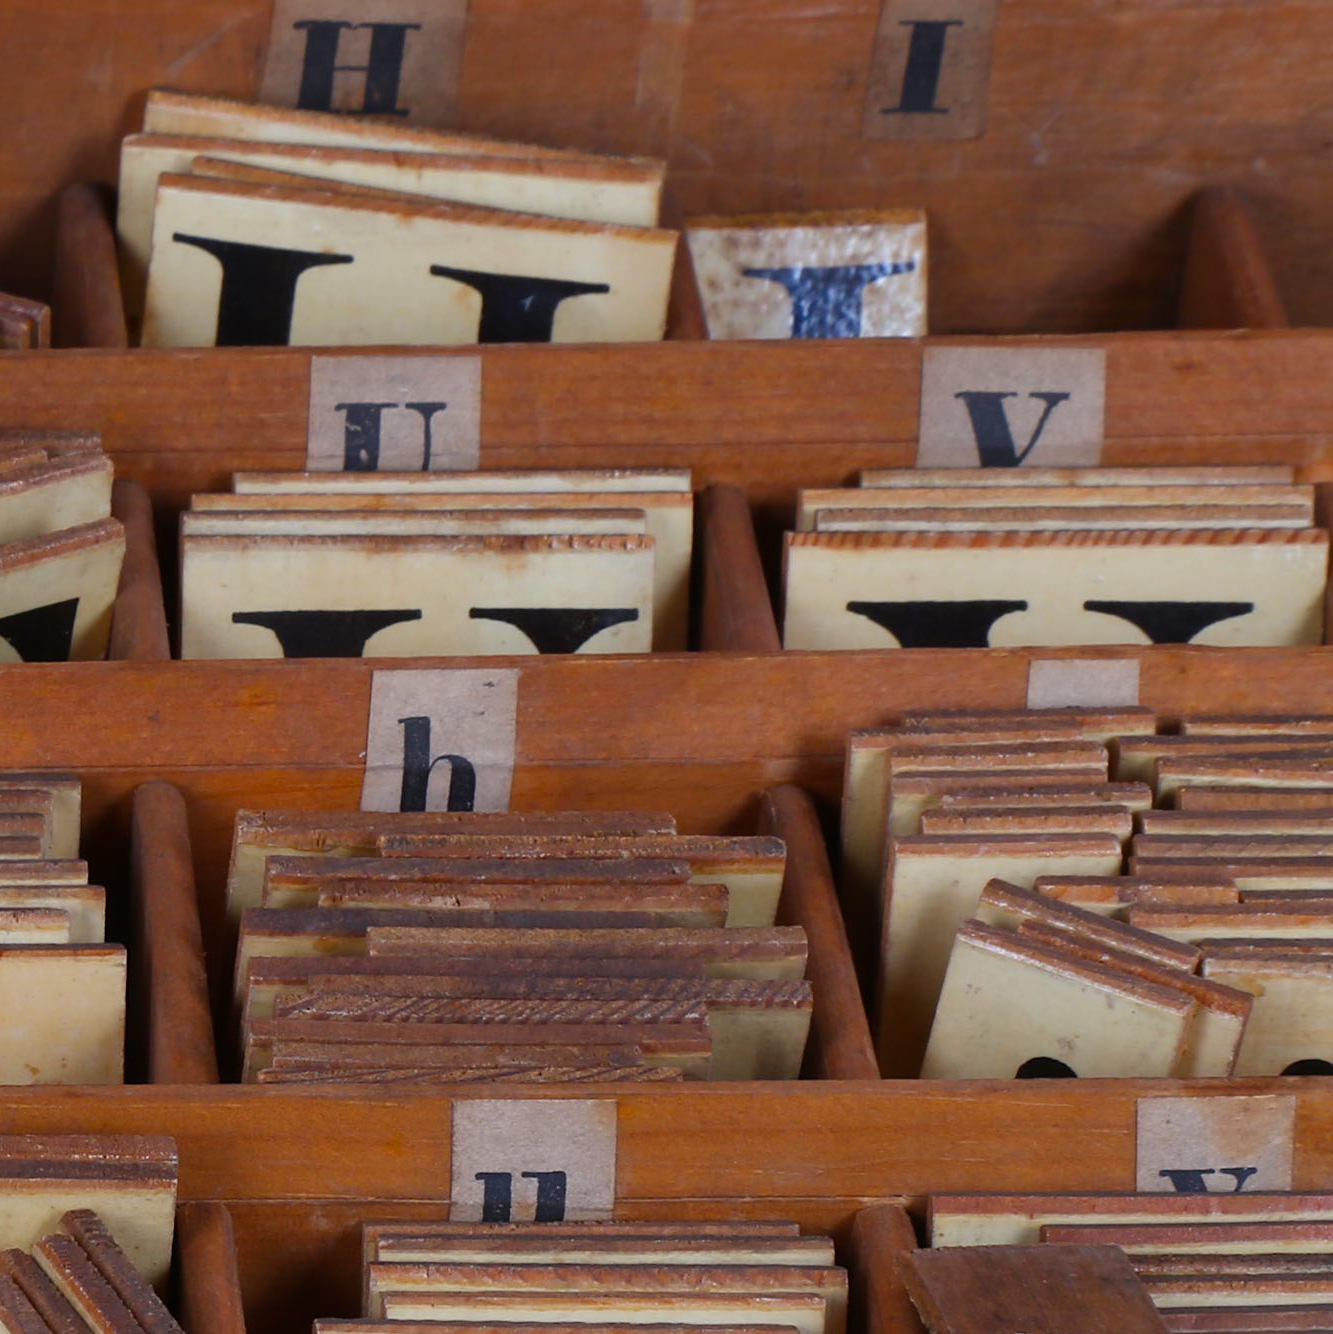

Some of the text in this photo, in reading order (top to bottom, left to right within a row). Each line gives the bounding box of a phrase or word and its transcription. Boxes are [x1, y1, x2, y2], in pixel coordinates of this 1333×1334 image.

[294, 20, 421, 117] H
[881, 20, 963, 115] I
[956, 392, 1068, 468] V
[399, 717, 475, 811] h
